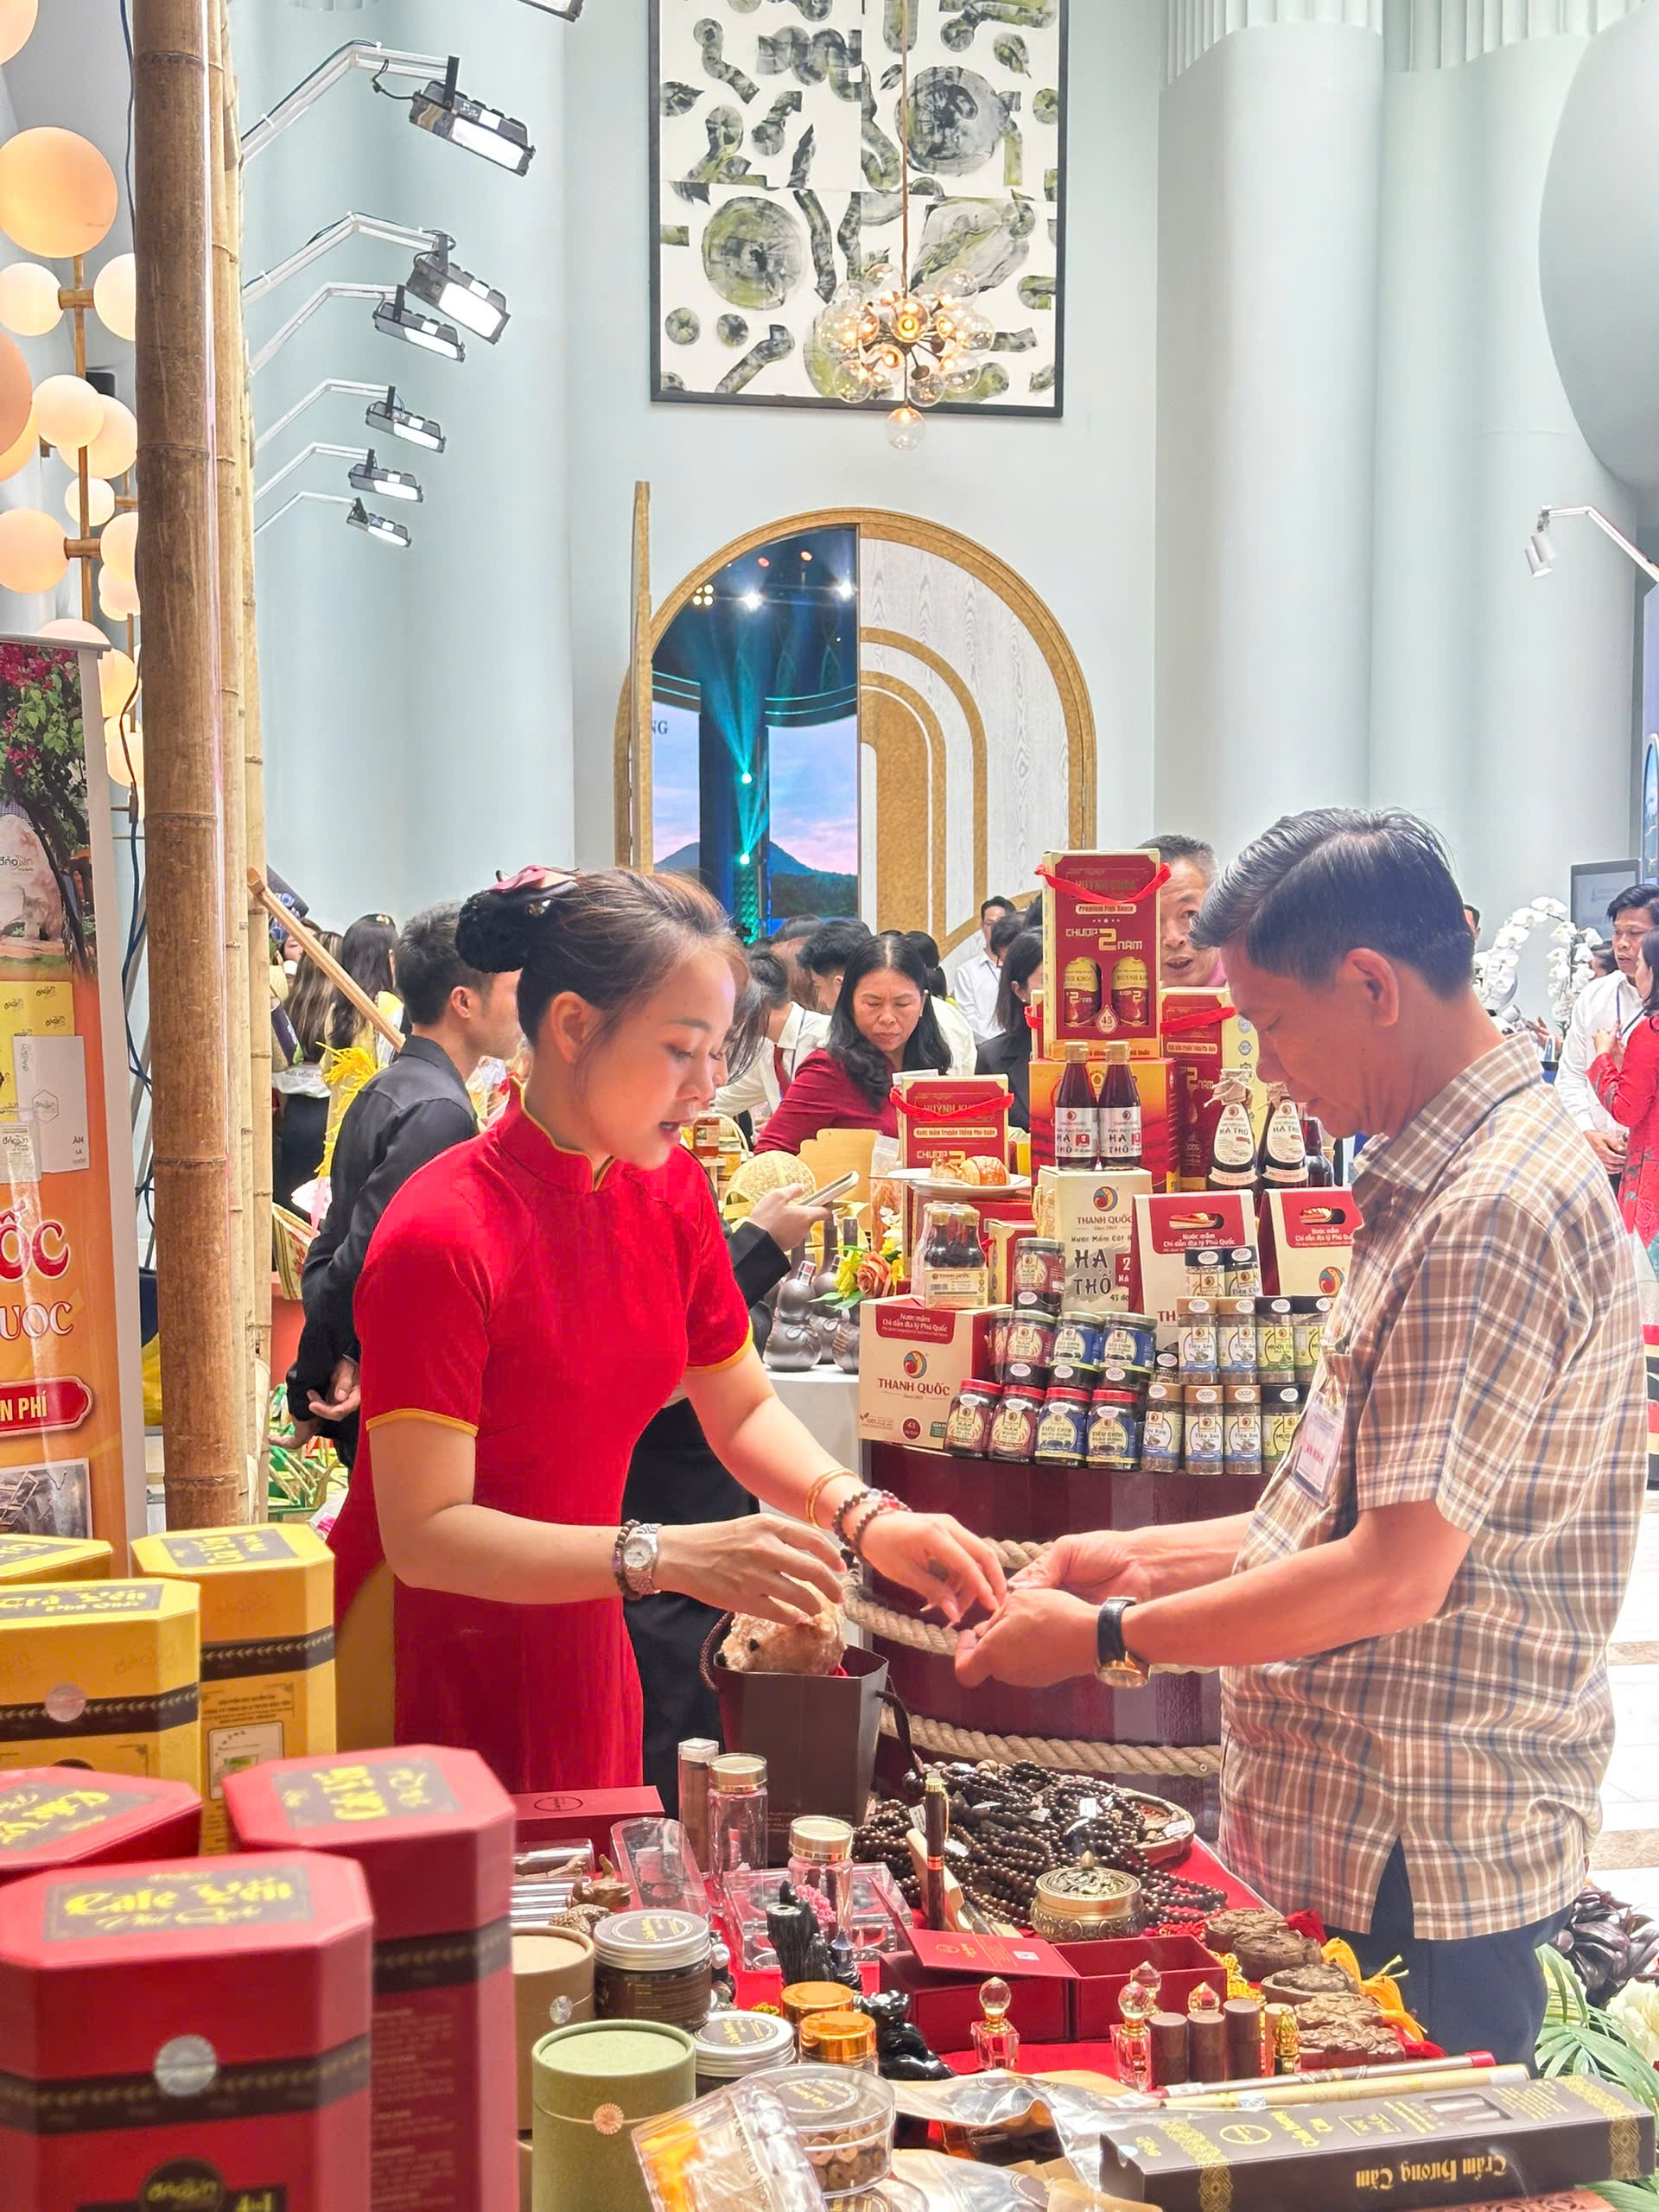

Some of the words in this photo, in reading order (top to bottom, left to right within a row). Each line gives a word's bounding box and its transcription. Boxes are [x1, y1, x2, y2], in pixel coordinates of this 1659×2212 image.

[1098, 927, 1117, 951] 2
[1077, 1216, 1106, 1224] THANH
[1122, 1256, 1131, 1271] 2
[878, 1377, 914, 1392] THANH
[917, 1382, 950, 1396] QUỐC
[18, 1389, 48, 1421] PHÍ
